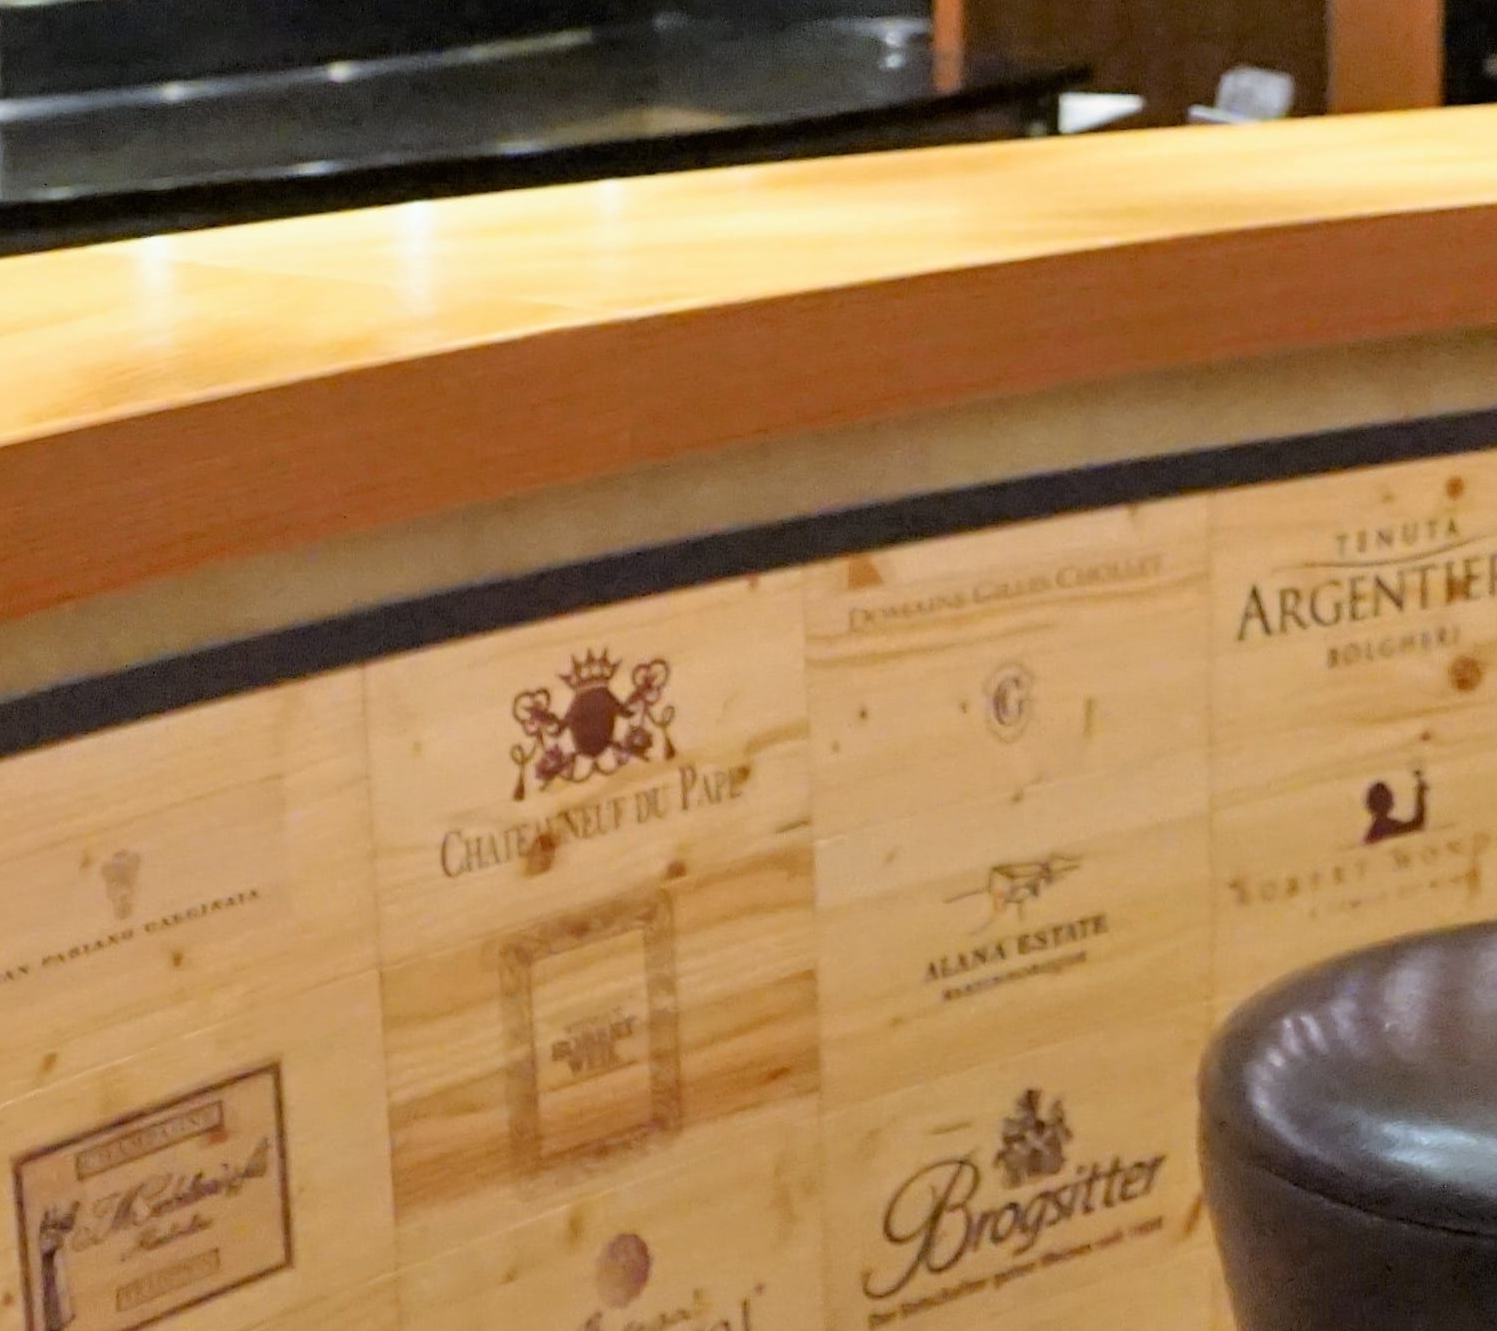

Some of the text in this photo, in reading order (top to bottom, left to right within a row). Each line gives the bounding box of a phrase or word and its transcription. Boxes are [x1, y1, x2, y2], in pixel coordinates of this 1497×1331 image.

[1335, 517, 1461, 558] TENUTA
[1017, 911, 1110, 956] ESTATE
[861, 1142, 1168, 1300] Brogsitter
